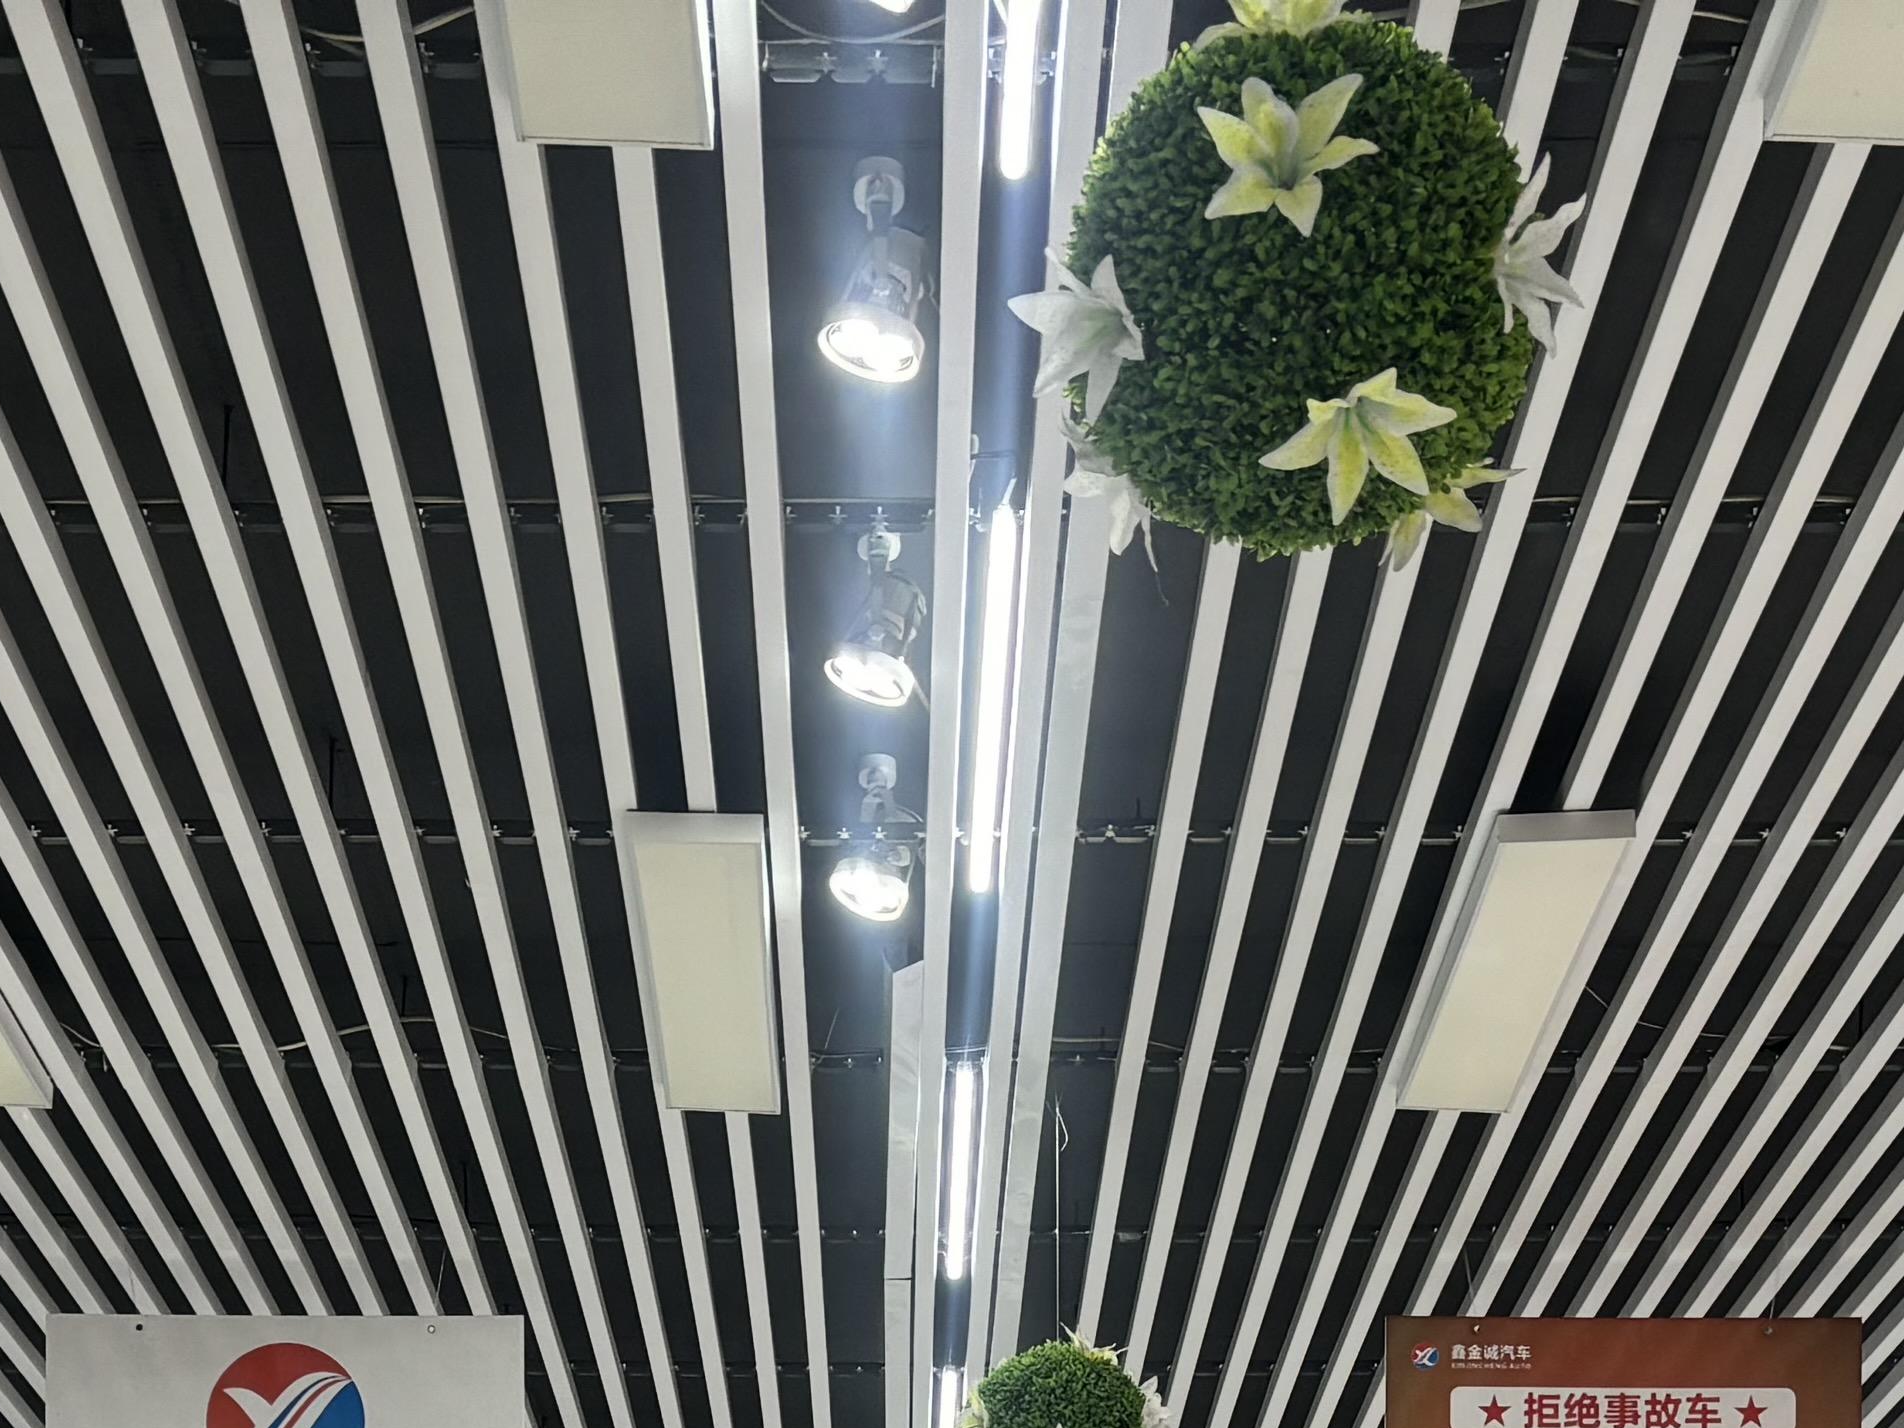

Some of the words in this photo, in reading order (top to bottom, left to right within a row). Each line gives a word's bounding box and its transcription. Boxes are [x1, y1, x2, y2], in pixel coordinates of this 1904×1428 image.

[1451, 1344, 1532, 1360] 鑫金诚汽车
